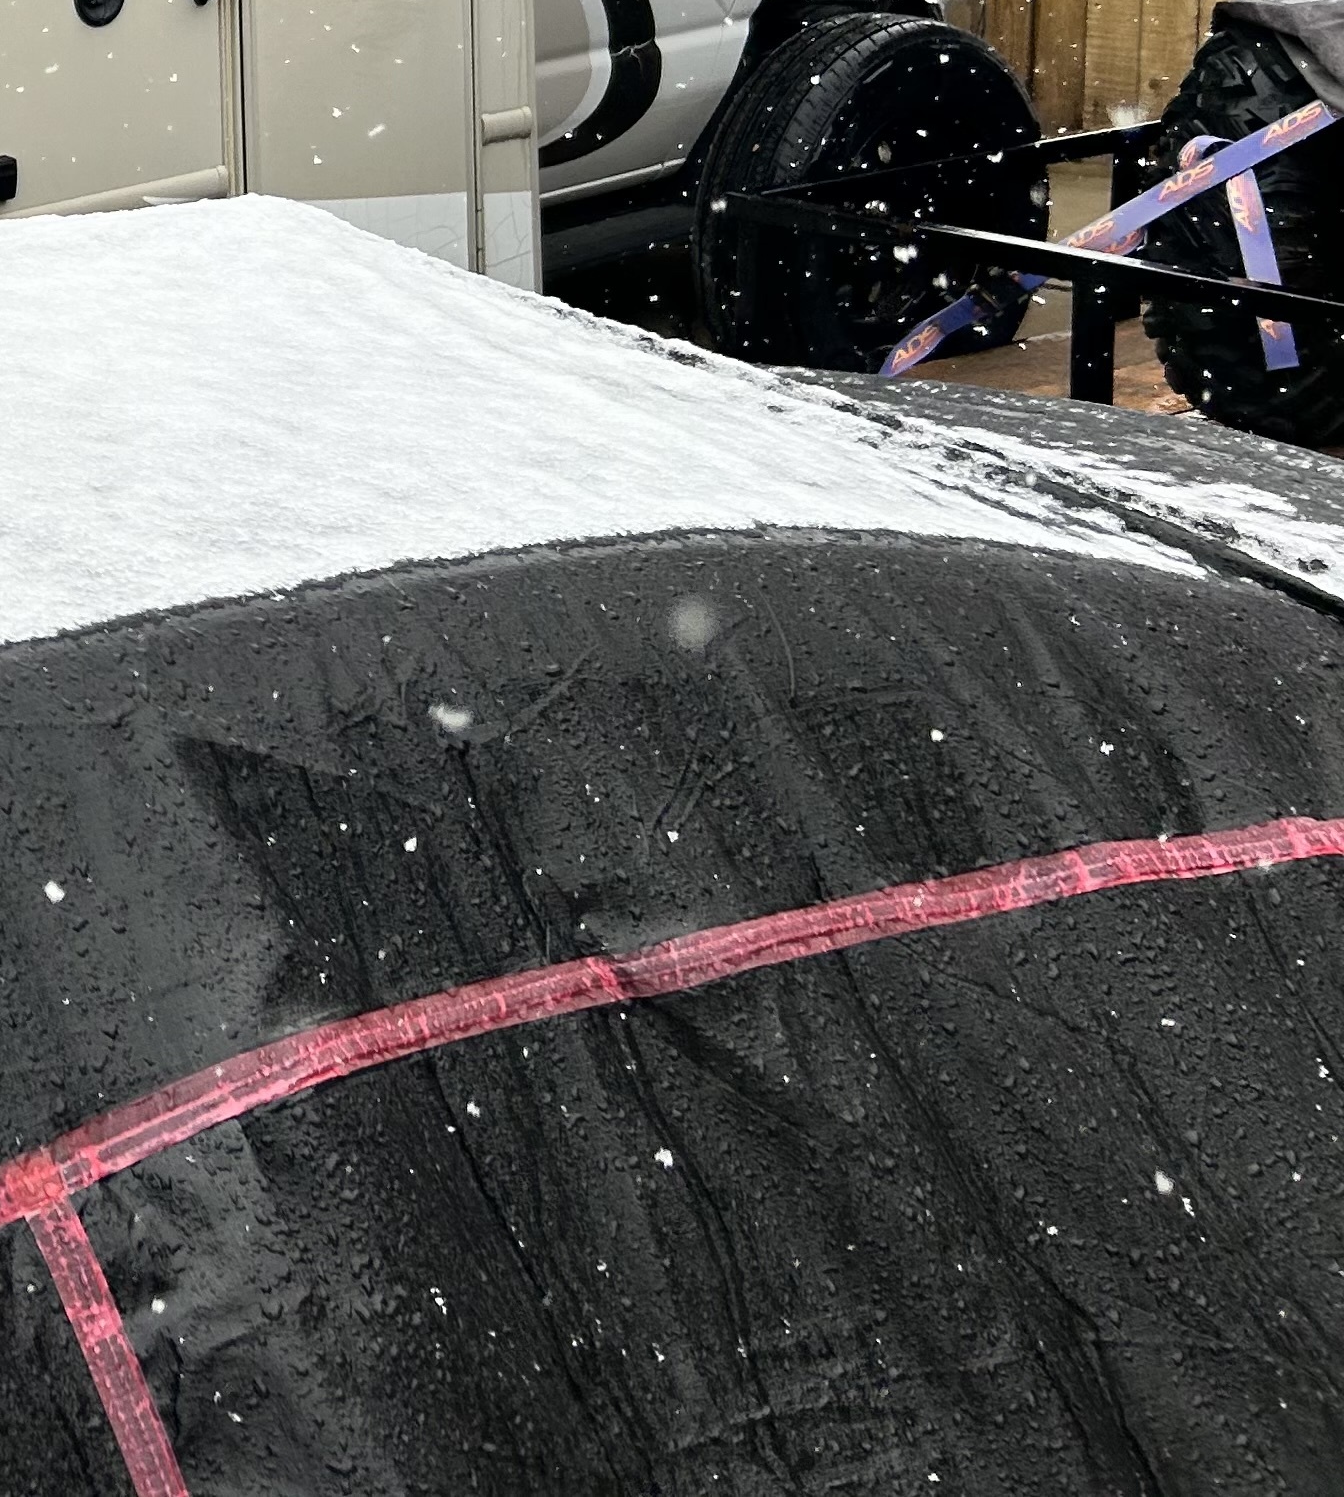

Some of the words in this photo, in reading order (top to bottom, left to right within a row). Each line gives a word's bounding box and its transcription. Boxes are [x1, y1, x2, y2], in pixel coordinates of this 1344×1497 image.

[1262, 102, 1323, 145] ADS
[1158, 158, 1215, 201] ADS
[891, 324, 940, 373] ADS
